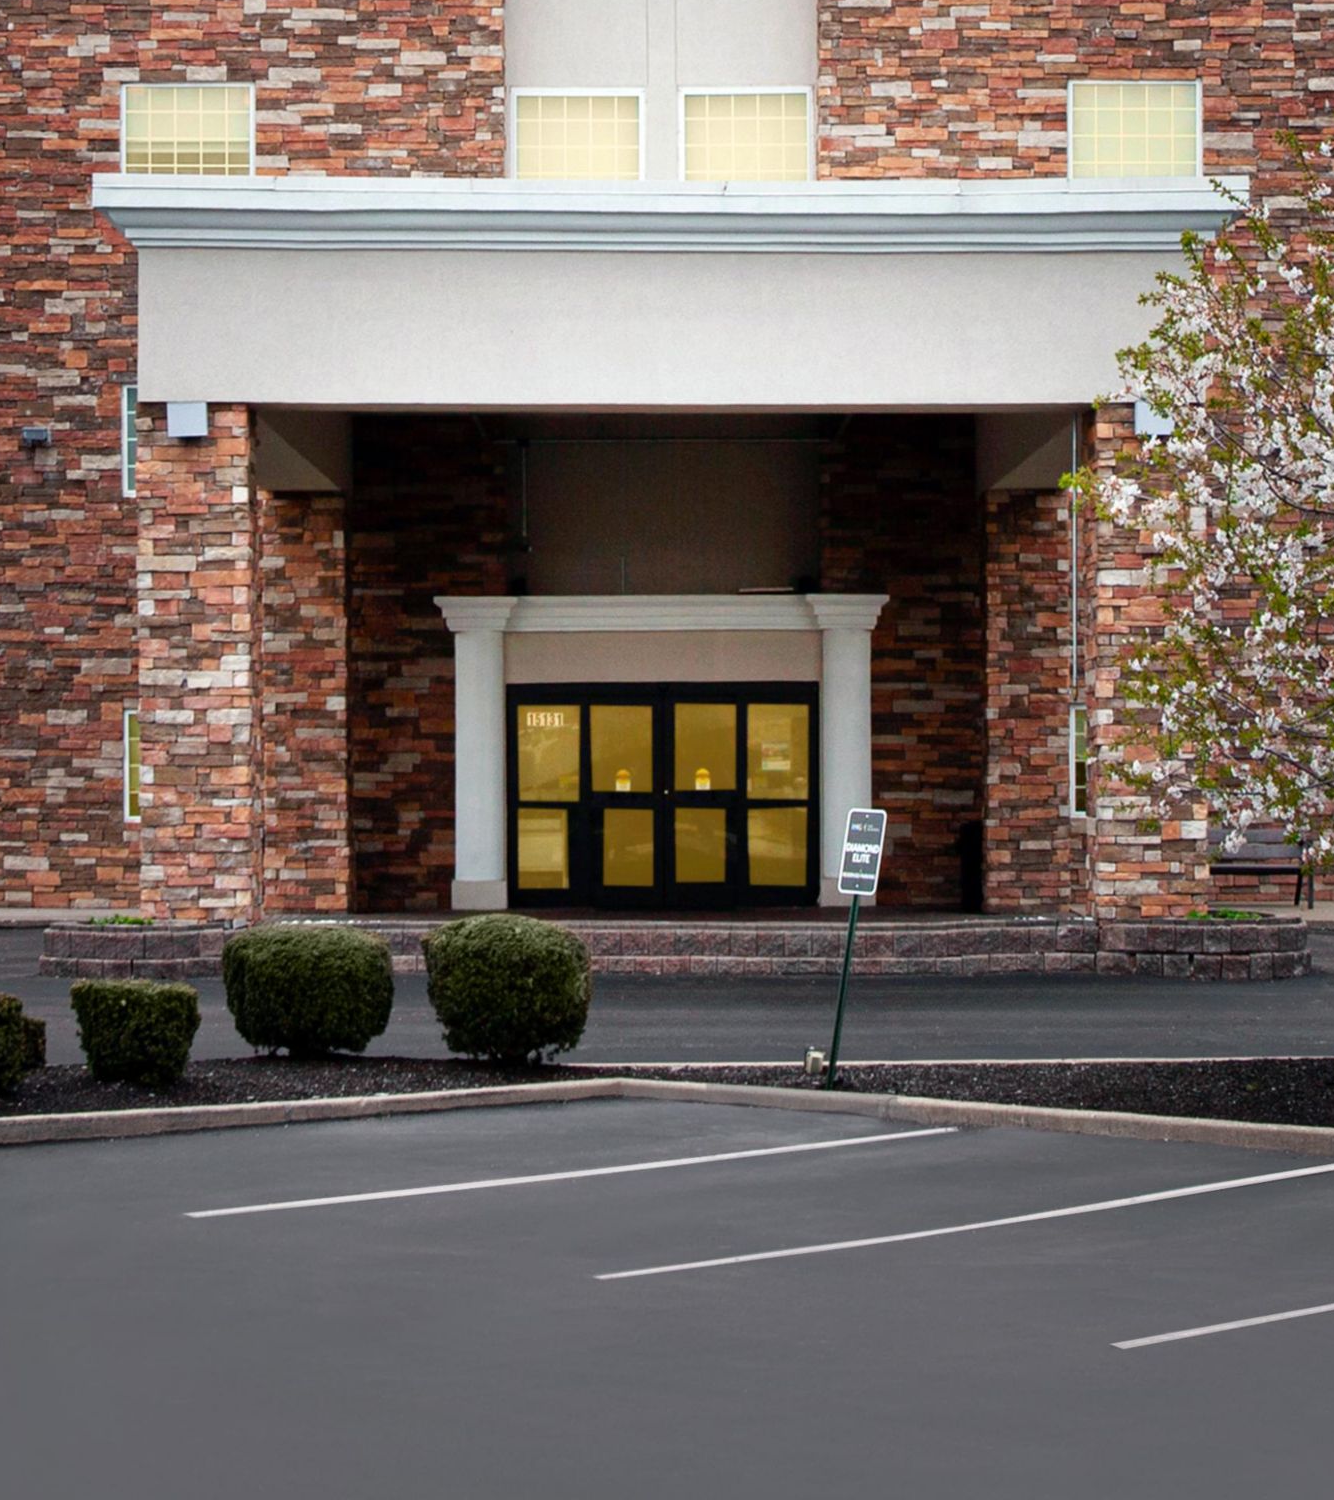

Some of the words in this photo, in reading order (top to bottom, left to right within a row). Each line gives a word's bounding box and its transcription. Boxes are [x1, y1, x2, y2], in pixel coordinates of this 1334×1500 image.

[527, 712, 564, 726] 15131
[846, 842, 880, 854] DIAMOND
[852, 853, 871, 864] ELITE
